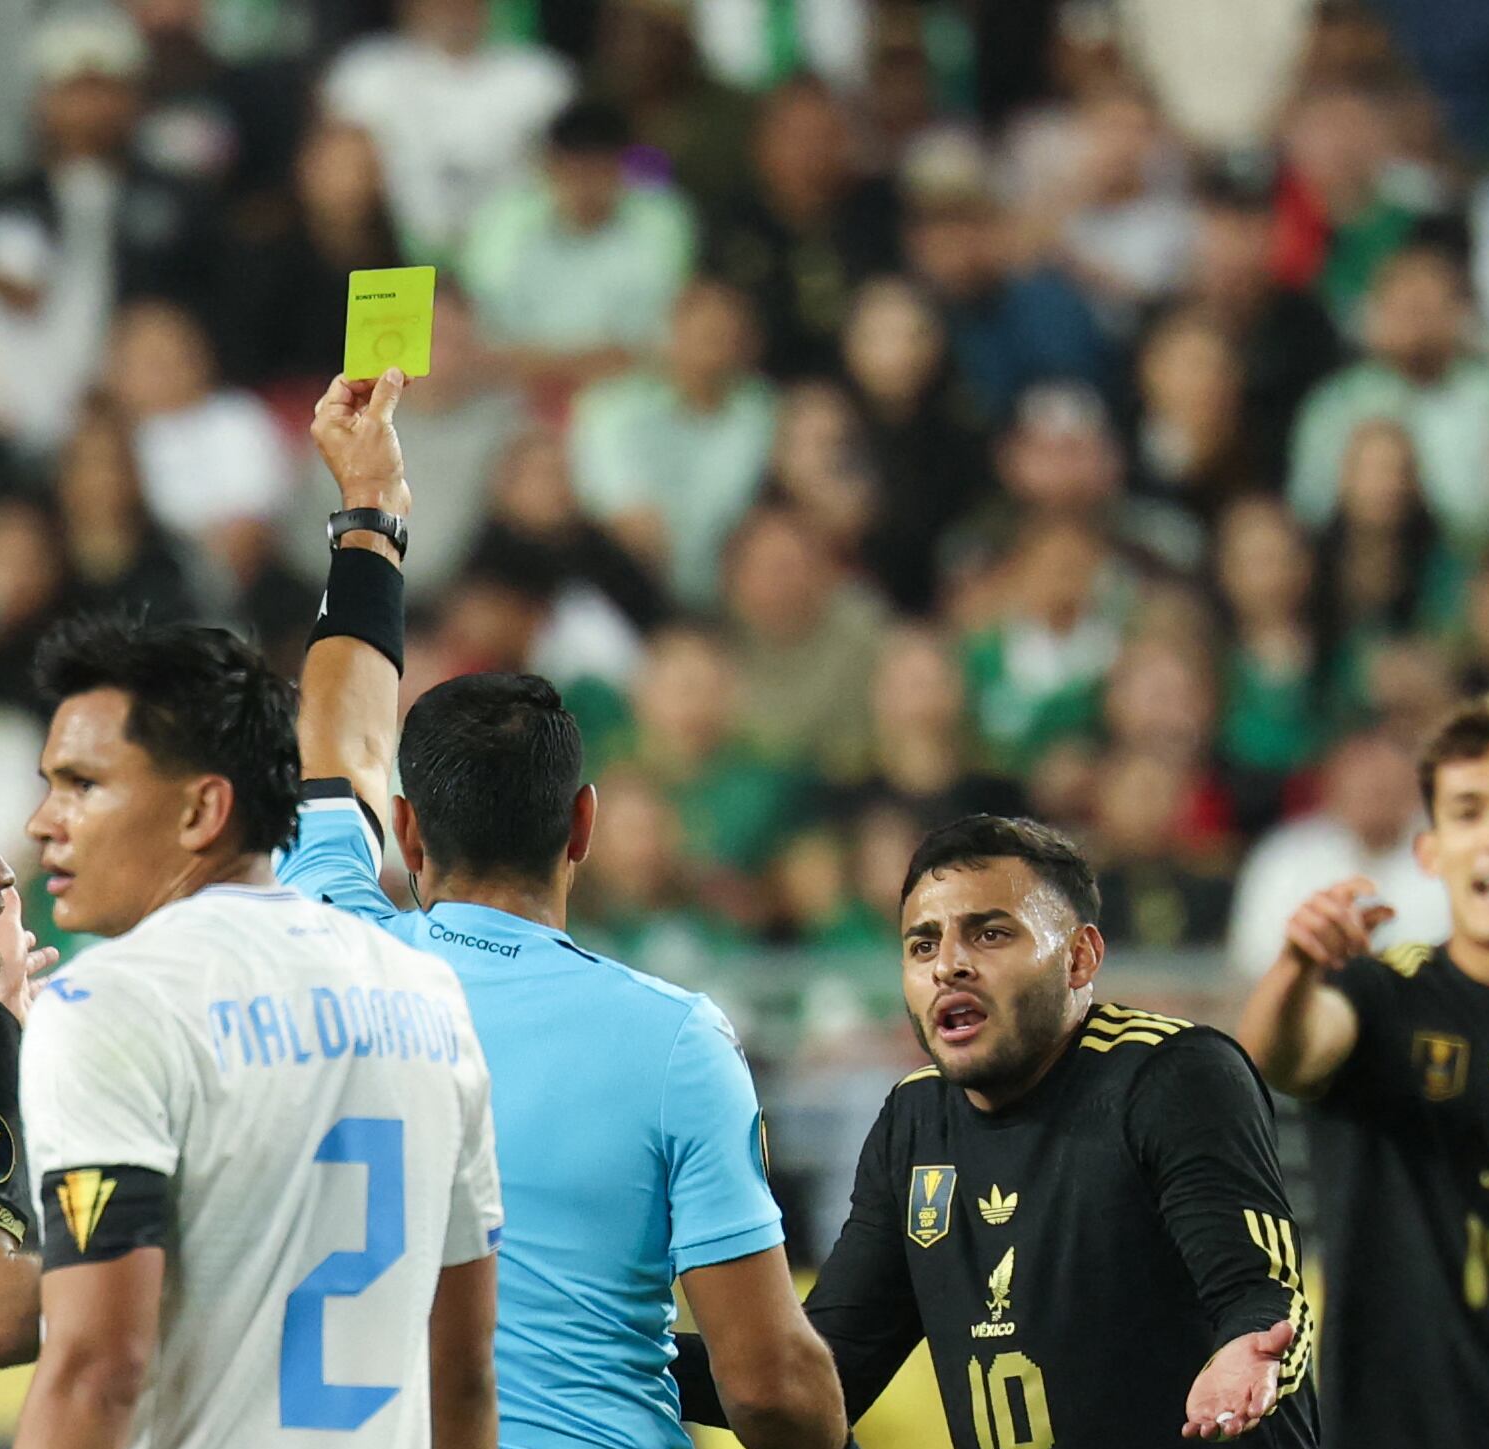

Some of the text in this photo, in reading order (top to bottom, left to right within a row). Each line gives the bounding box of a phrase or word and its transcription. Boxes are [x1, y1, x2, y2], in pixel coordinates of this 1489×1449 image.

[428, 923, 522, 961] Concacaf
[209, 986, 460, 1073] MALDONADO
[280, 1117, 405, 1432] 2
